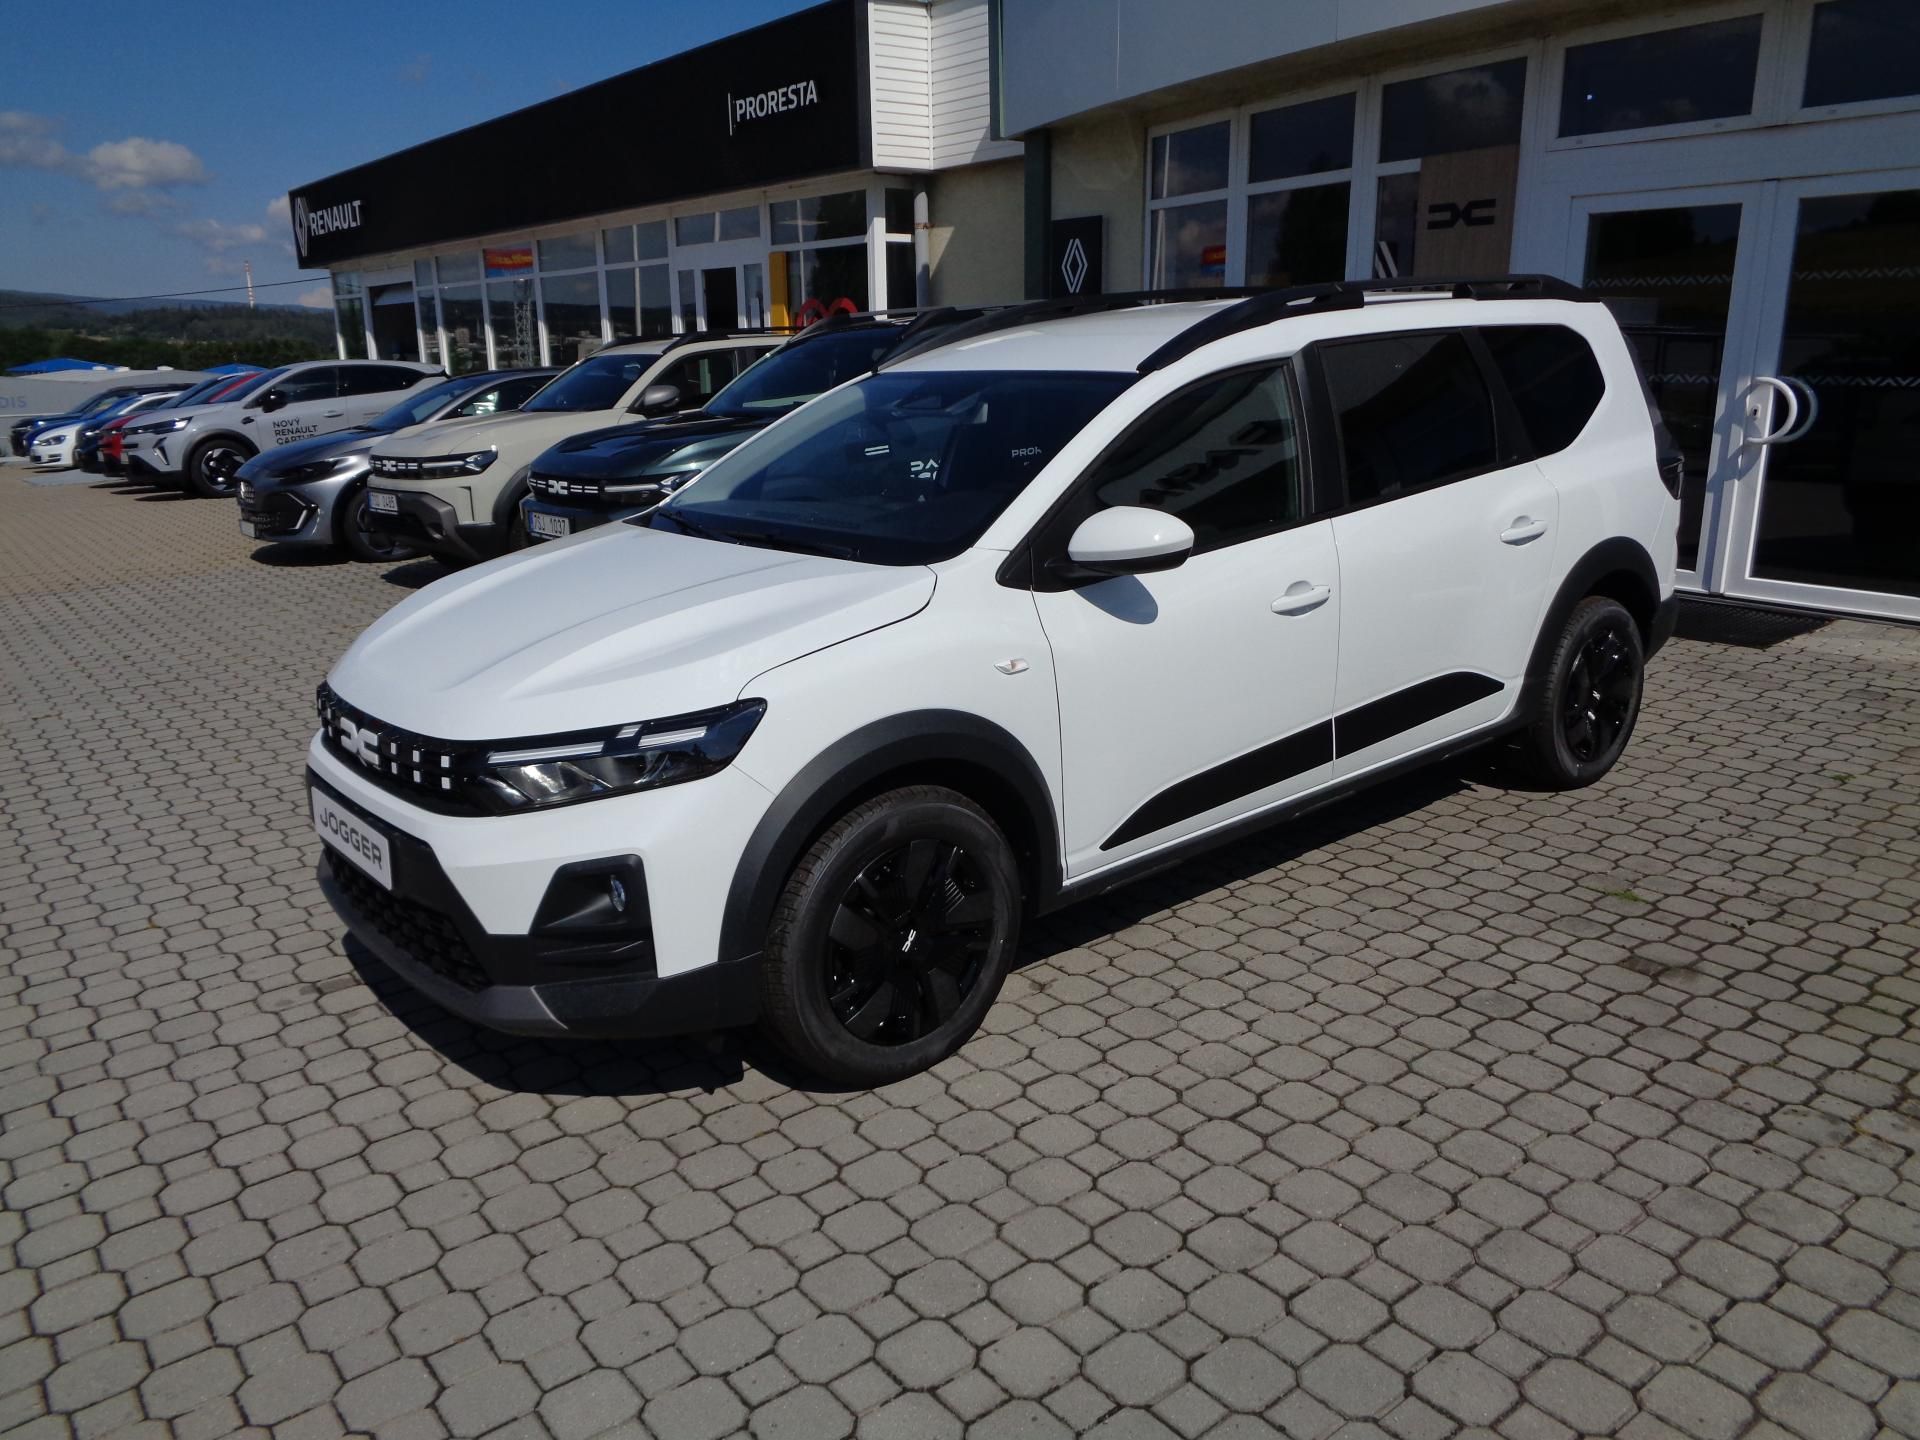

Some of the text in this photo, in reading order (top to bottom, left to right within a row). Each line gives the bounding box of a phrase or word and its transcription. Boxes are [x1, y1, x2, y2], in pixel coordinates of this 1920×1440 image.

[736, 80, 817, 122] PRORESTA
[309, 200, 361, 236] RENAULT
[274, 424, 318, 437] RENAULT
[550, 517, 566, 536] 1037
[320, 808, 383, 871] JOGGER
